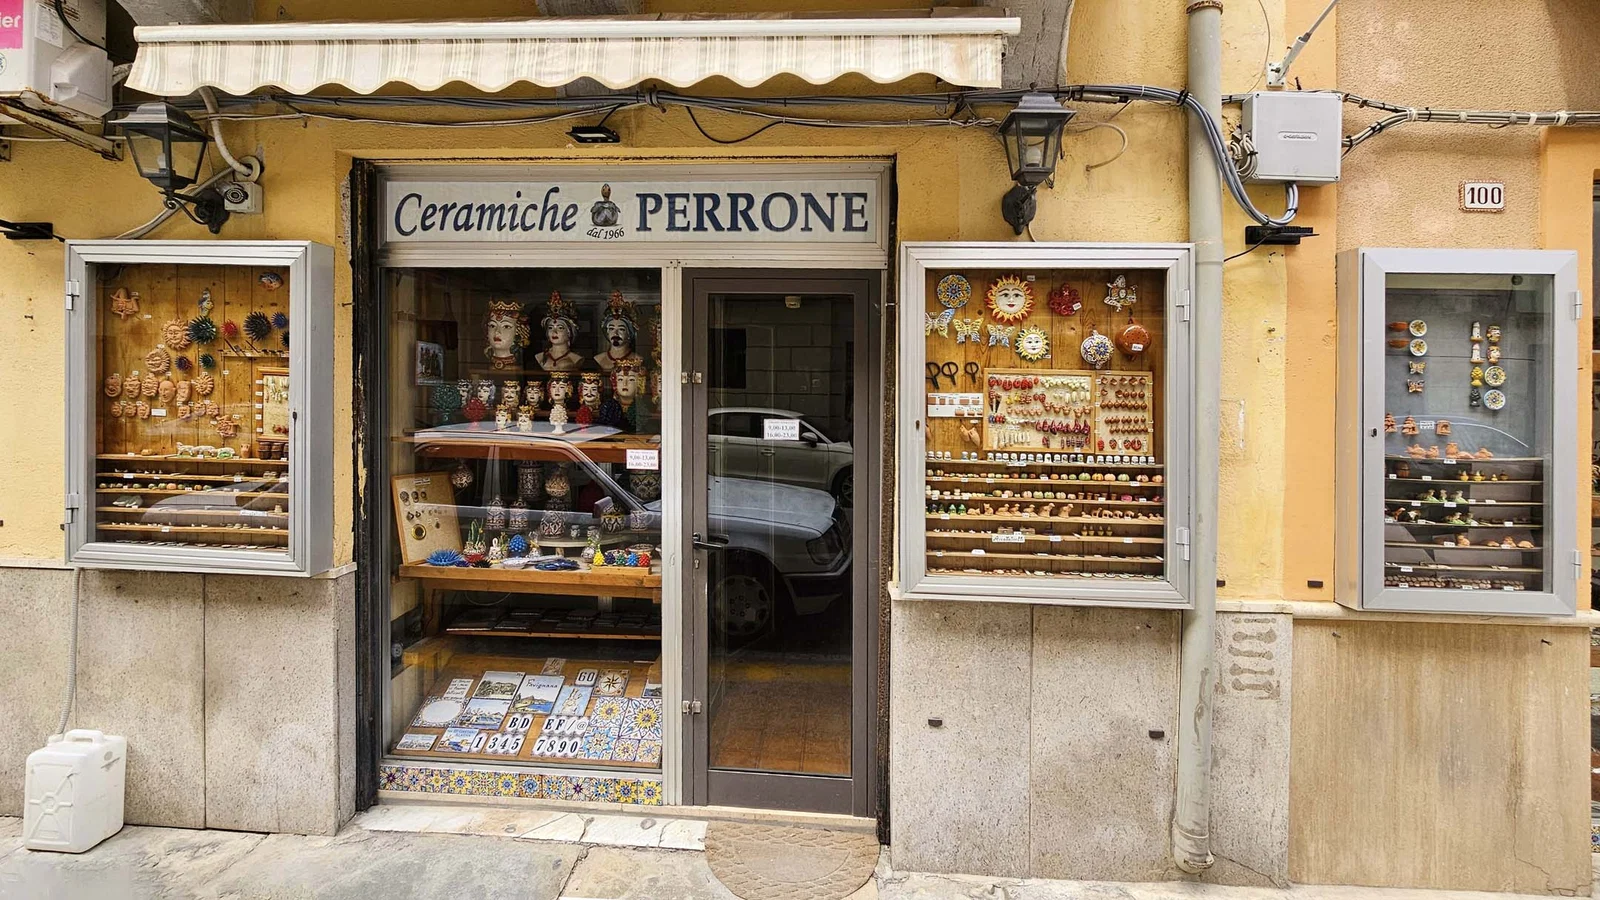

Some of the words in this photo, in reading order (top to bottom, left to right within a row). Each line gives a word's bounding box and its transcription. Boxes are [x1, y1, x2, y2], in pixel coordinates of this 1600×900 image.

[1467, 187, 1502, 204] 100
[395, 186, 578, 236] Ceramiche
[636, 192, 868, 232] PERRONE
[586, 228, 604, 238] dal
[603, 227, 625, 239] 1966
[578, 672, 596, 682] 60
[526, 679, 558, 689] Favignana
